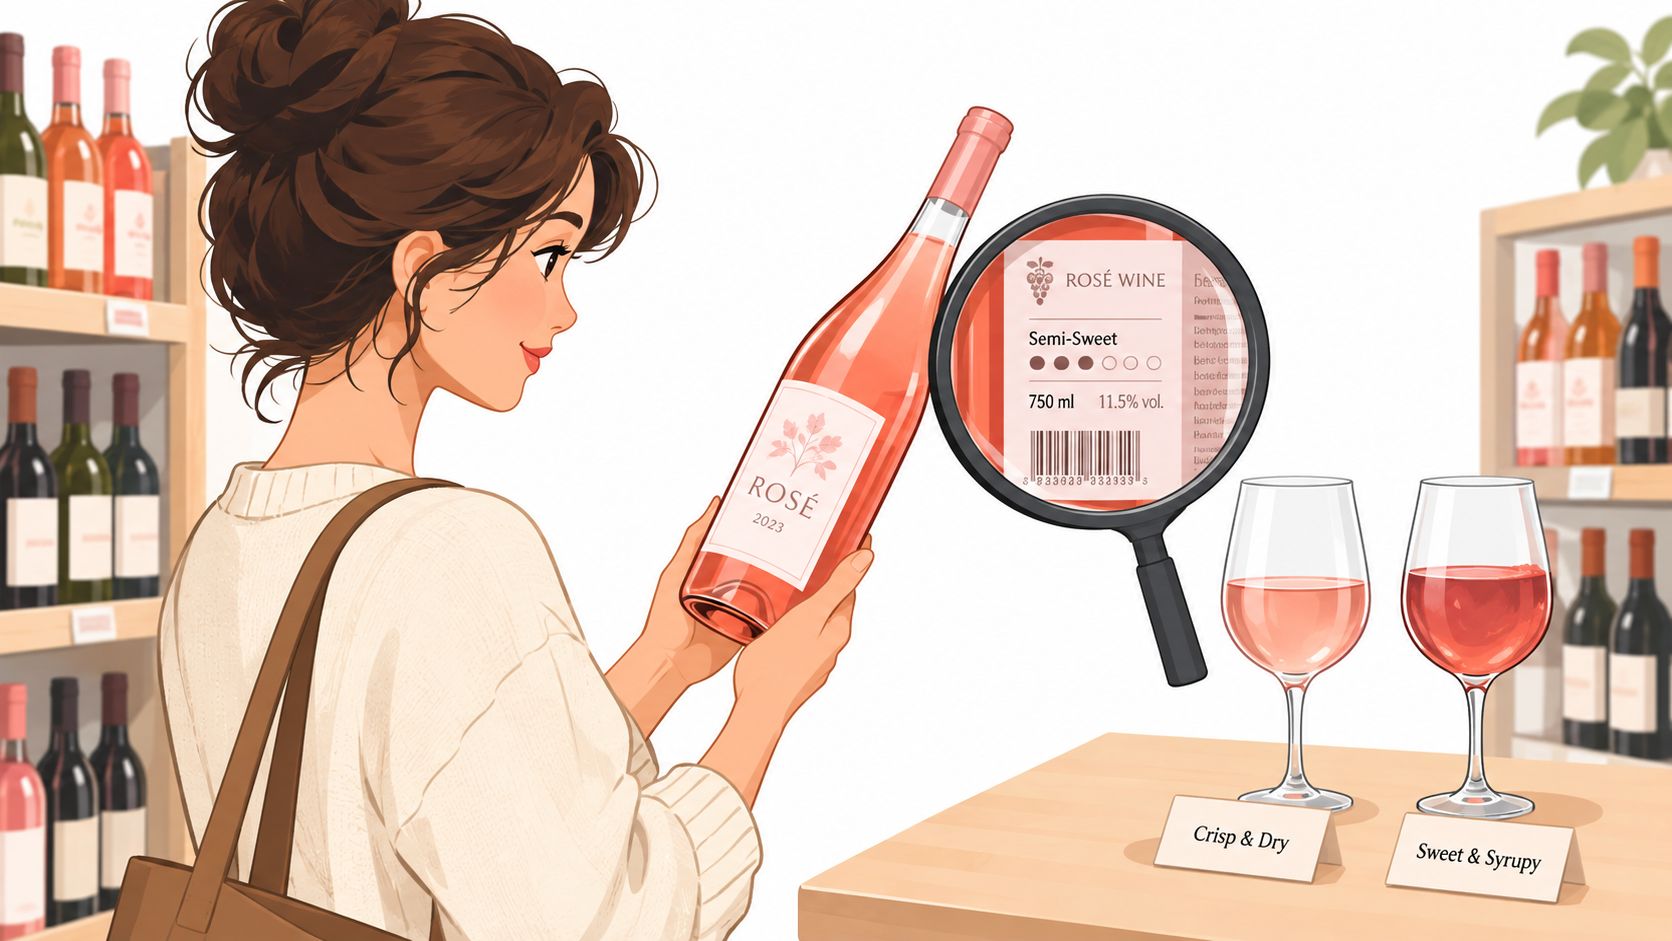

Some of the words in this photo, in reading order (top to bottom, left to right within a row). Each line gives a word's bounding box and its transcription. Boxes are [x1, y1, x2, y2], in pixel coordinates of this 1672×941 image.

[1066, 269, 1112, 288] ROSÉ
[1118, 273, 1166, 288] WINE
[1029, 331, 1118, 346] Semi-Sweet
[1029, 394, 1054, 409] 750
[1058, 393, 1075, 409] ml
[1099, 394, 1139, 409] 11.5%
[1142, 393, 1164, 409] vol.
[747, 476, 819, 520] ROSÉ
[752, 512, 785, 533] 2023
[1193, 825, 1237, 849] Crisp
[1240, 830, 1254, 847] &
[1258, 831, 1290, 855] Dry
[1416, 842, 1464, 862] Sweet
[1467, 848, 1481, 864] &
[1485, 849, 1542, 875] Syrupy
